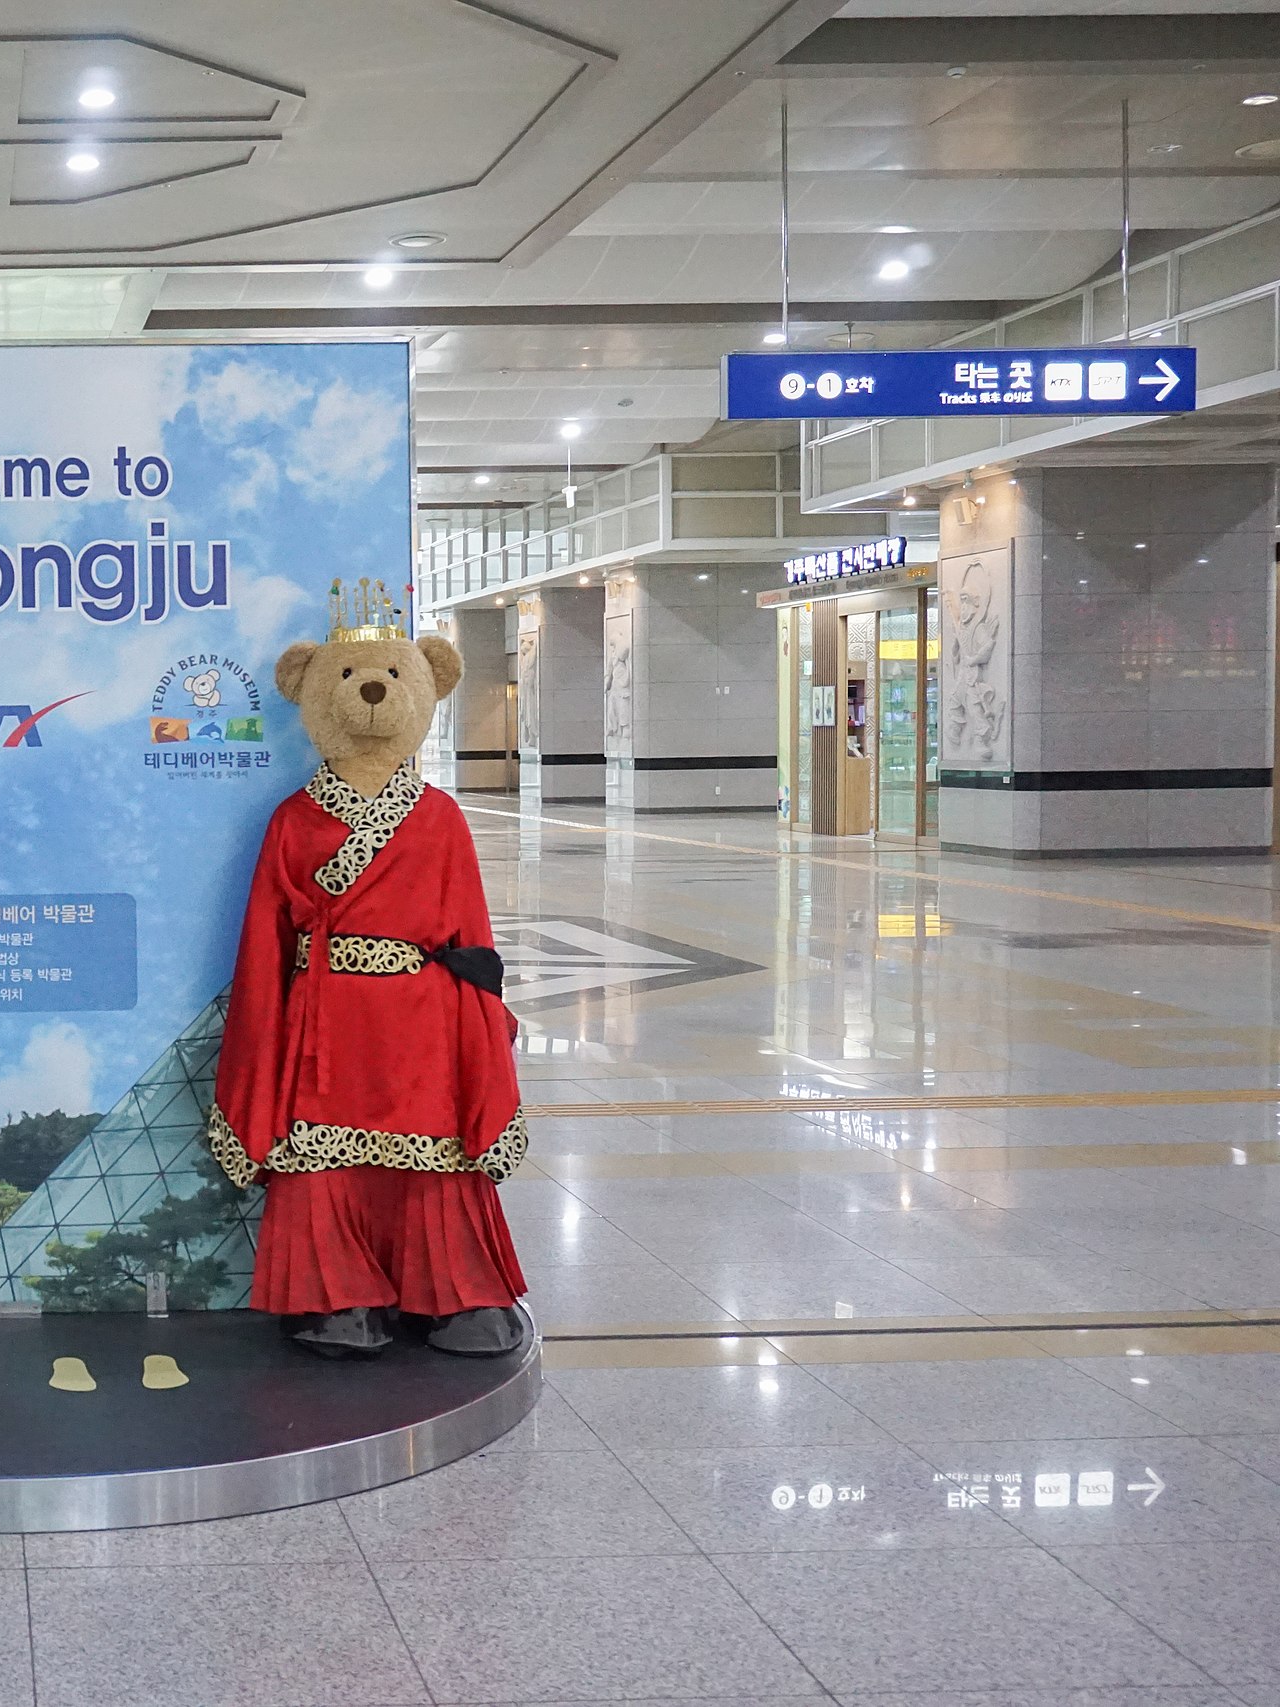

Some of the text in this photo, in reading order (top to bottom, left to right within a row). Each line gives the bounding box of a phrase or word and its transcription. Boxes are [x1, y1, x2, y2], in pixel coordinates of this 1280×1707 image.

[954, 361, 1032, 389] 타는 곳
[939, 393, 977, 404] Tracks
[113, 444, 171, 498] to
[178, 654, 218, 671] BEAR
[152, 667, 177, 712] TEDDY
[222, 658, 261, 712] MUSEUM
[144, 751, 271, 769] 테디베어박물관
[43, 903, 95, 924] 박물관
[0, 933, 33, 946] 박물관
[10, 968, 33, 982] 등록
[37, 968, 72, 981] 박물관
[0, 988, 23, 1001] 위치
